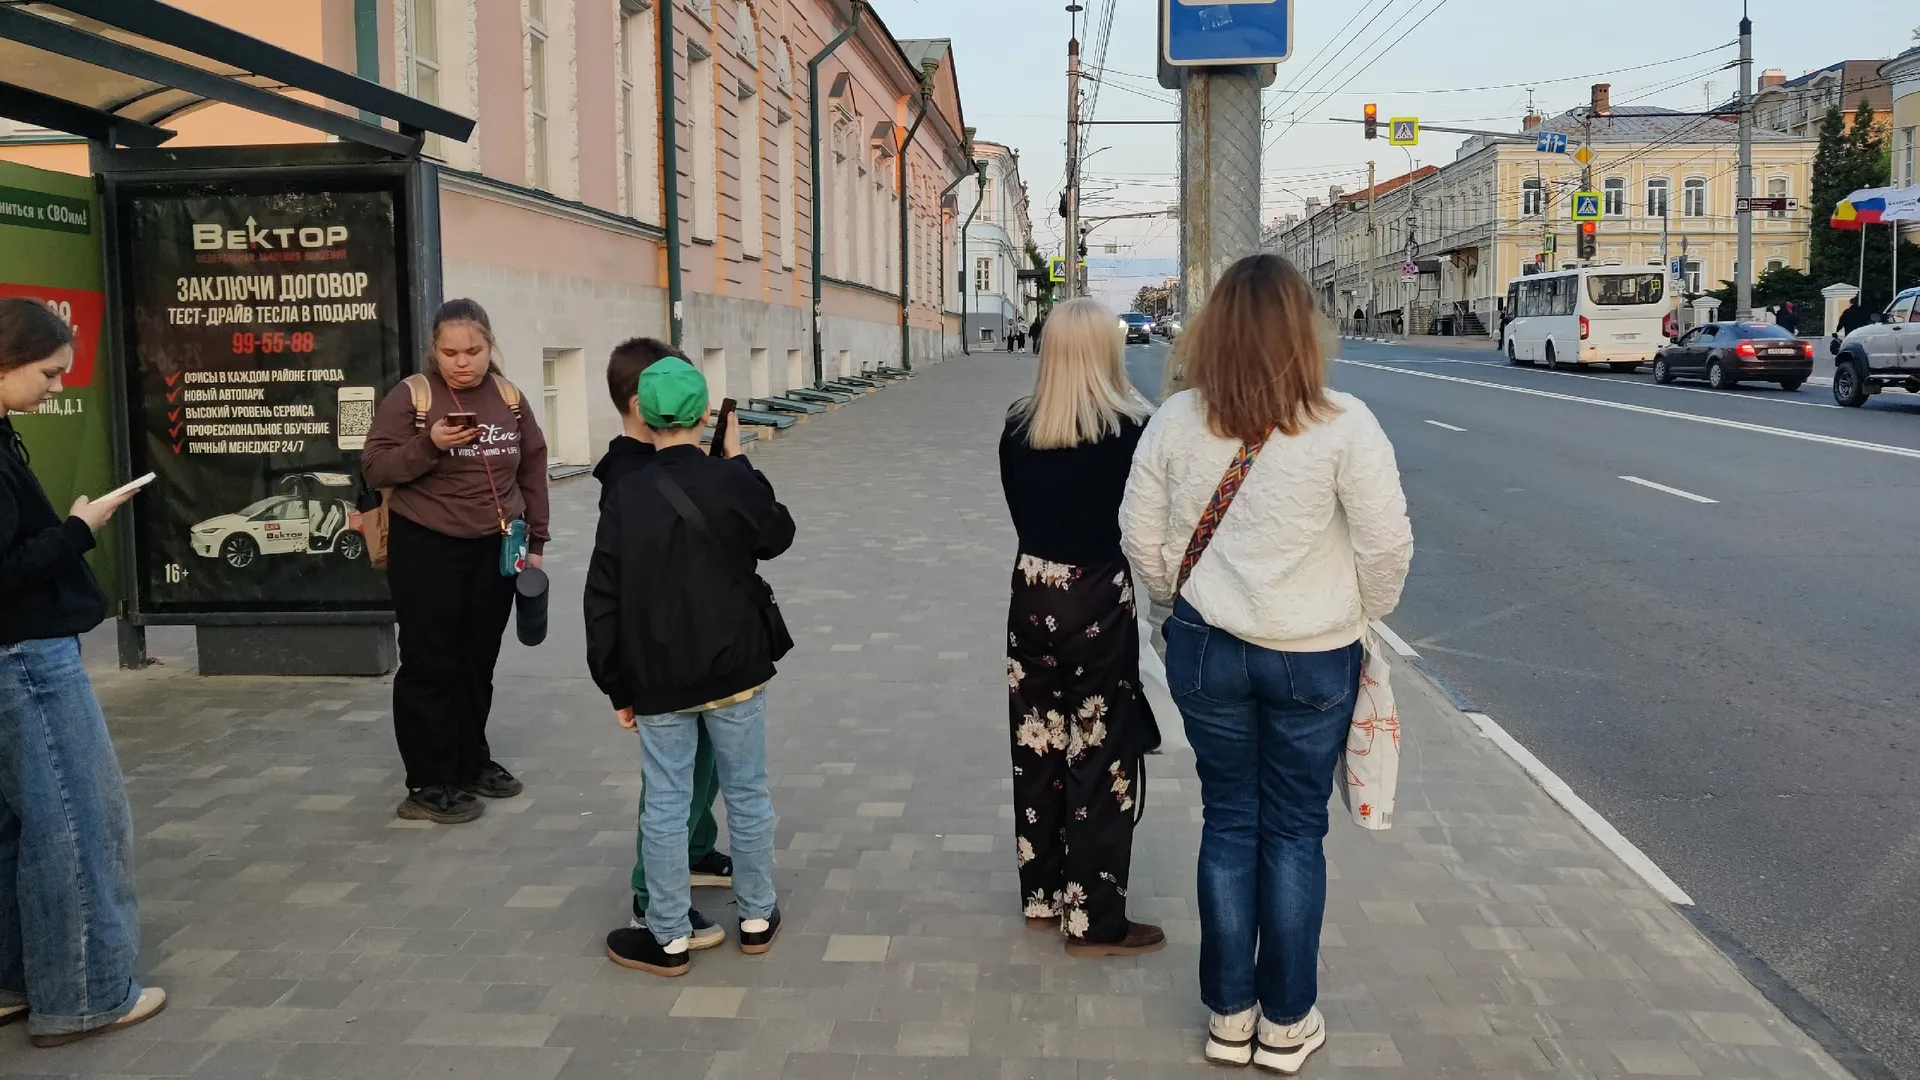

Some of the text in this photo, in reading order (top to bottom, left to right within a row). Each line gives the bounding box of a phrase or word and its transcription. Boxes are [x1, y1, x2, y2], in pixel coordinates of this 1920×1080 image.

[176, 272, 368, 302] ЗАКЛЮЧИ ДОГОВОР
[168, 303, 377, 326] ТЕСТ-ДРАЙВ ТЕСЛА В ПОДАРОК
[232, 332, 315, 354] 99-55-88
[184, 368, 344, 384] ОФИСЫ В КАЖДОМ РАЙОНЕ ГОРОДА
[184, 388, 265, 402] НОВЫЙ АВТОПАРК
[185, 405, 315, 419] ВЫСОКИЙ УРОВЕНЬ СЕРВИСА
[186, 422, 330, 437] ПРОФЕССИОНАЛЬНОЕ ОБУЧЕНИЕ
[189, 440, 304, 454] ЛИЧНЫЙ МЕНЕДЖЕР 24/7
[164, 563, 190, 584] 16+
